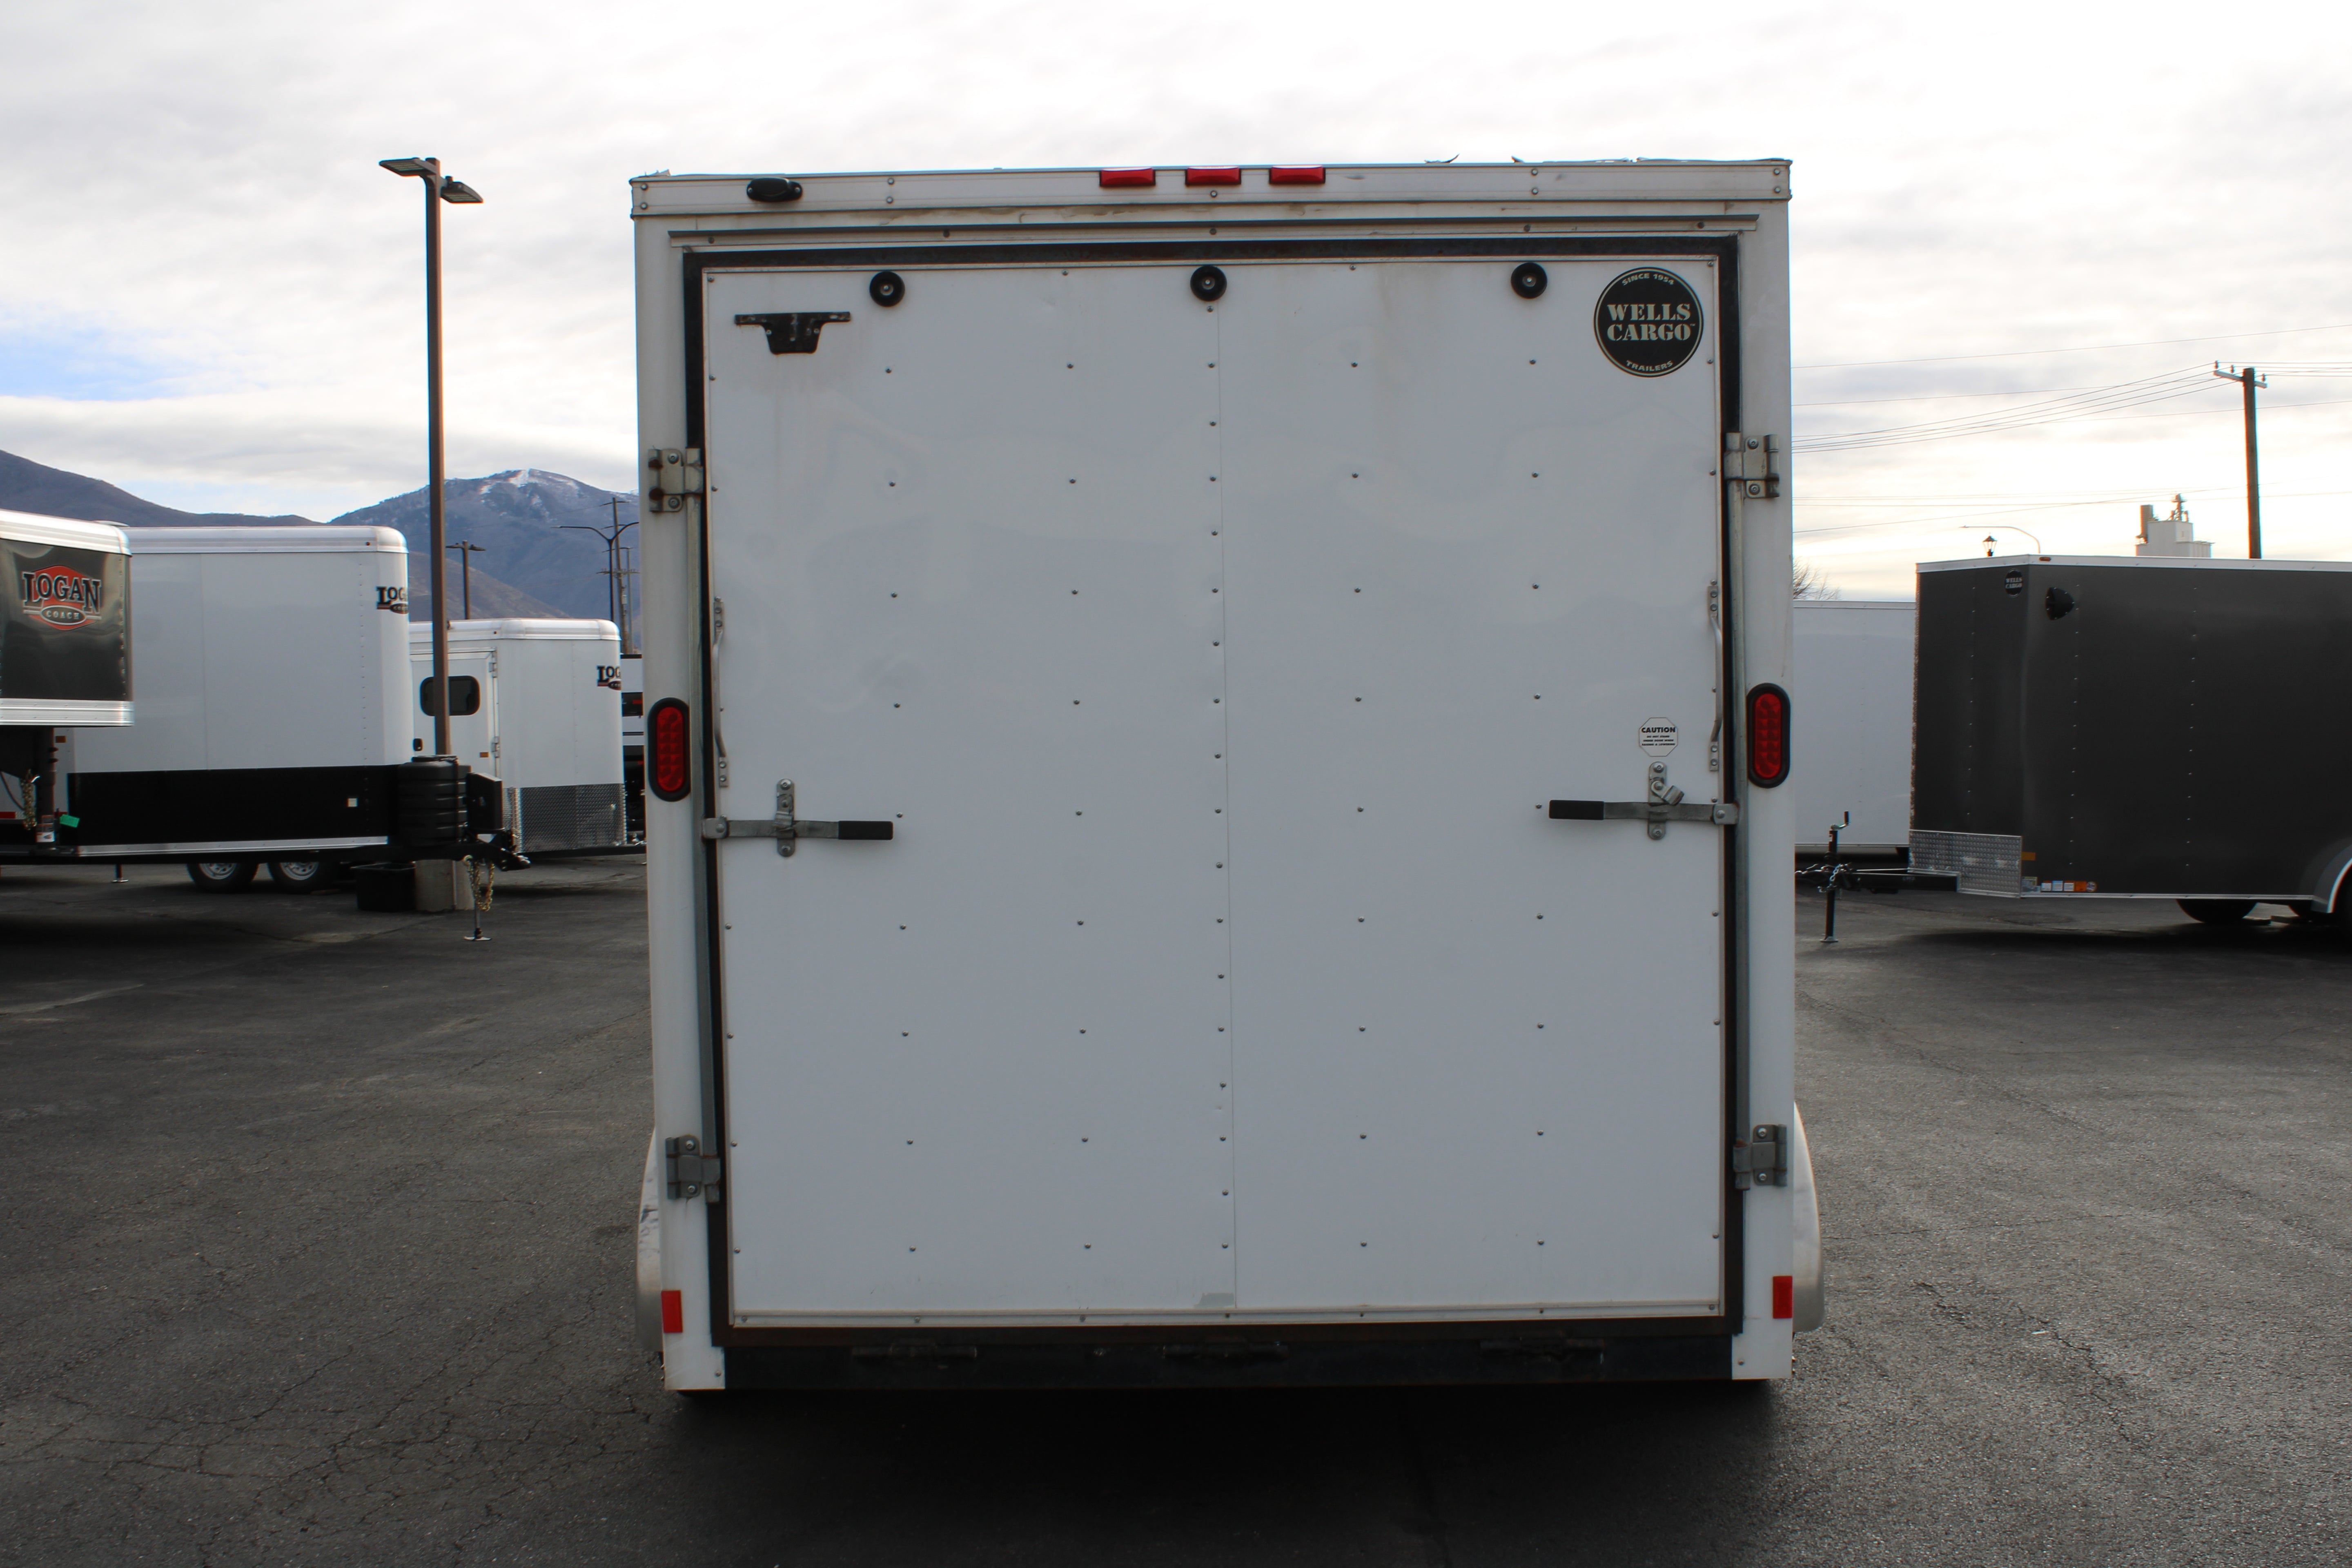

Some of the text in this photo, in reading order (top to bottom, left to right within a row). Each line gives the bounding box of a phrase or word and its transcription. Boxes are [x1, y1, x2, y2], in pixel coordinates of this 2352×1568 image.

[1622, 273, 1674, 285] SINCE 1954
[1607, 303, 1691, 321] WELLS
[1607, 323, 1691, 341] CARGO
[1626, 360, 1673, 372] TRAILERS
[22, 571, 102, 614] LOGAN
[46, 610, 80, 620] COACH
